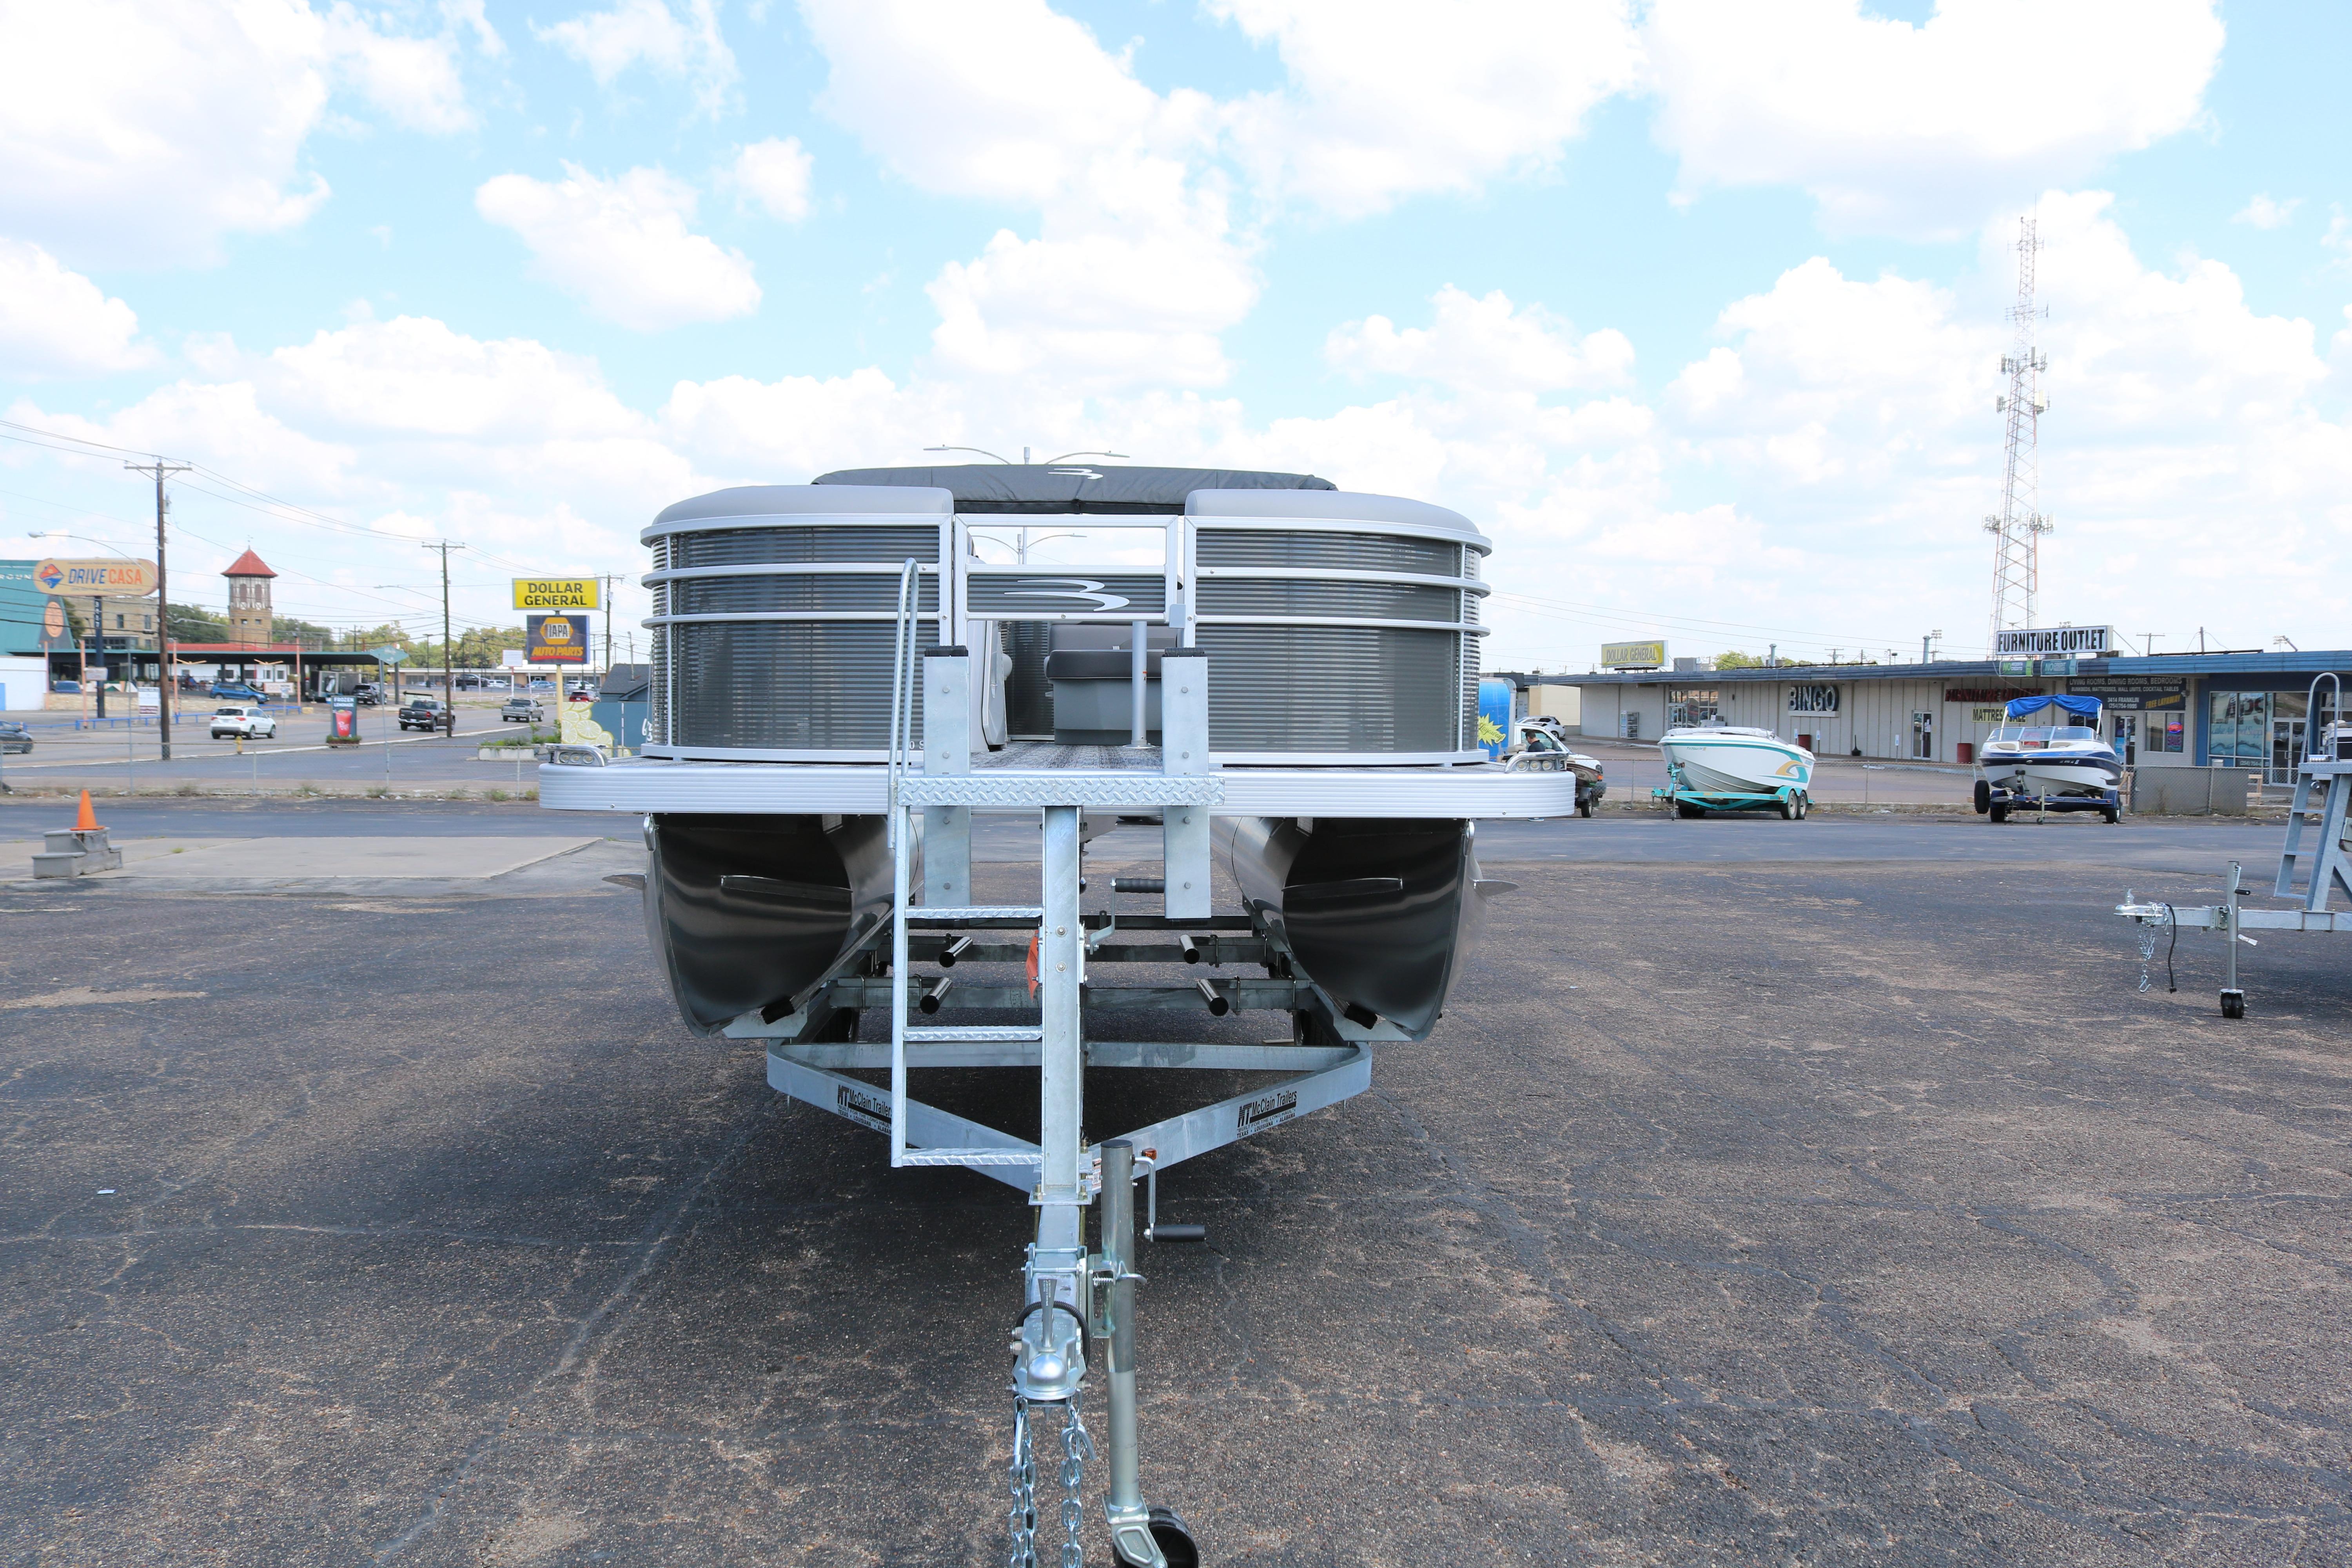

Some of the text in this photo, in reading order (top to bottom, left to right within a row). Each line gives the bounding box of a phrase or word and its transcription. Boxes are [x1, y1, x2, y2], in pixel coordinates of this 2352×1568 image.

[69, 568, 142, 584] DRIVE CASA
[528, 583, 583, 593] DOLLAR
[524, 595, 587, 605] GENERAL
[1998, 630, 2105, 652] FURNITURE OUTLET
[532, 647, 583, 656] AUTO PARTS
[1606, 647, 1656, 662] DOLLAR GENERAL
[2003, 662, 2011, 671] NO
[2045, 663, 2053, 671] NO
[1788, 686, 1836, 712] BINGO
[1945, 688, 1998, 702] FURNITURE
[2145, 694, 2181, 709] FREE LAYAWAY
[1973, 709, 2004, 722] MATTRES
[849, 1089, 871, 1109] McClain
[873, 1098, 892, 1117] Trailer
[1252, 1096, 1275, 1116] McClain
[1277, 1090, 1297, 1107] Trailers
[838, 1109, 848, 1117] TEXAS
[853, 1115, 871, 1126] LOUISIANA
[1270, 1114, 1281, 1122] LONG
[1237, 1113, 1295, 1138] TEXAS LOUISIANA ALABAMA
